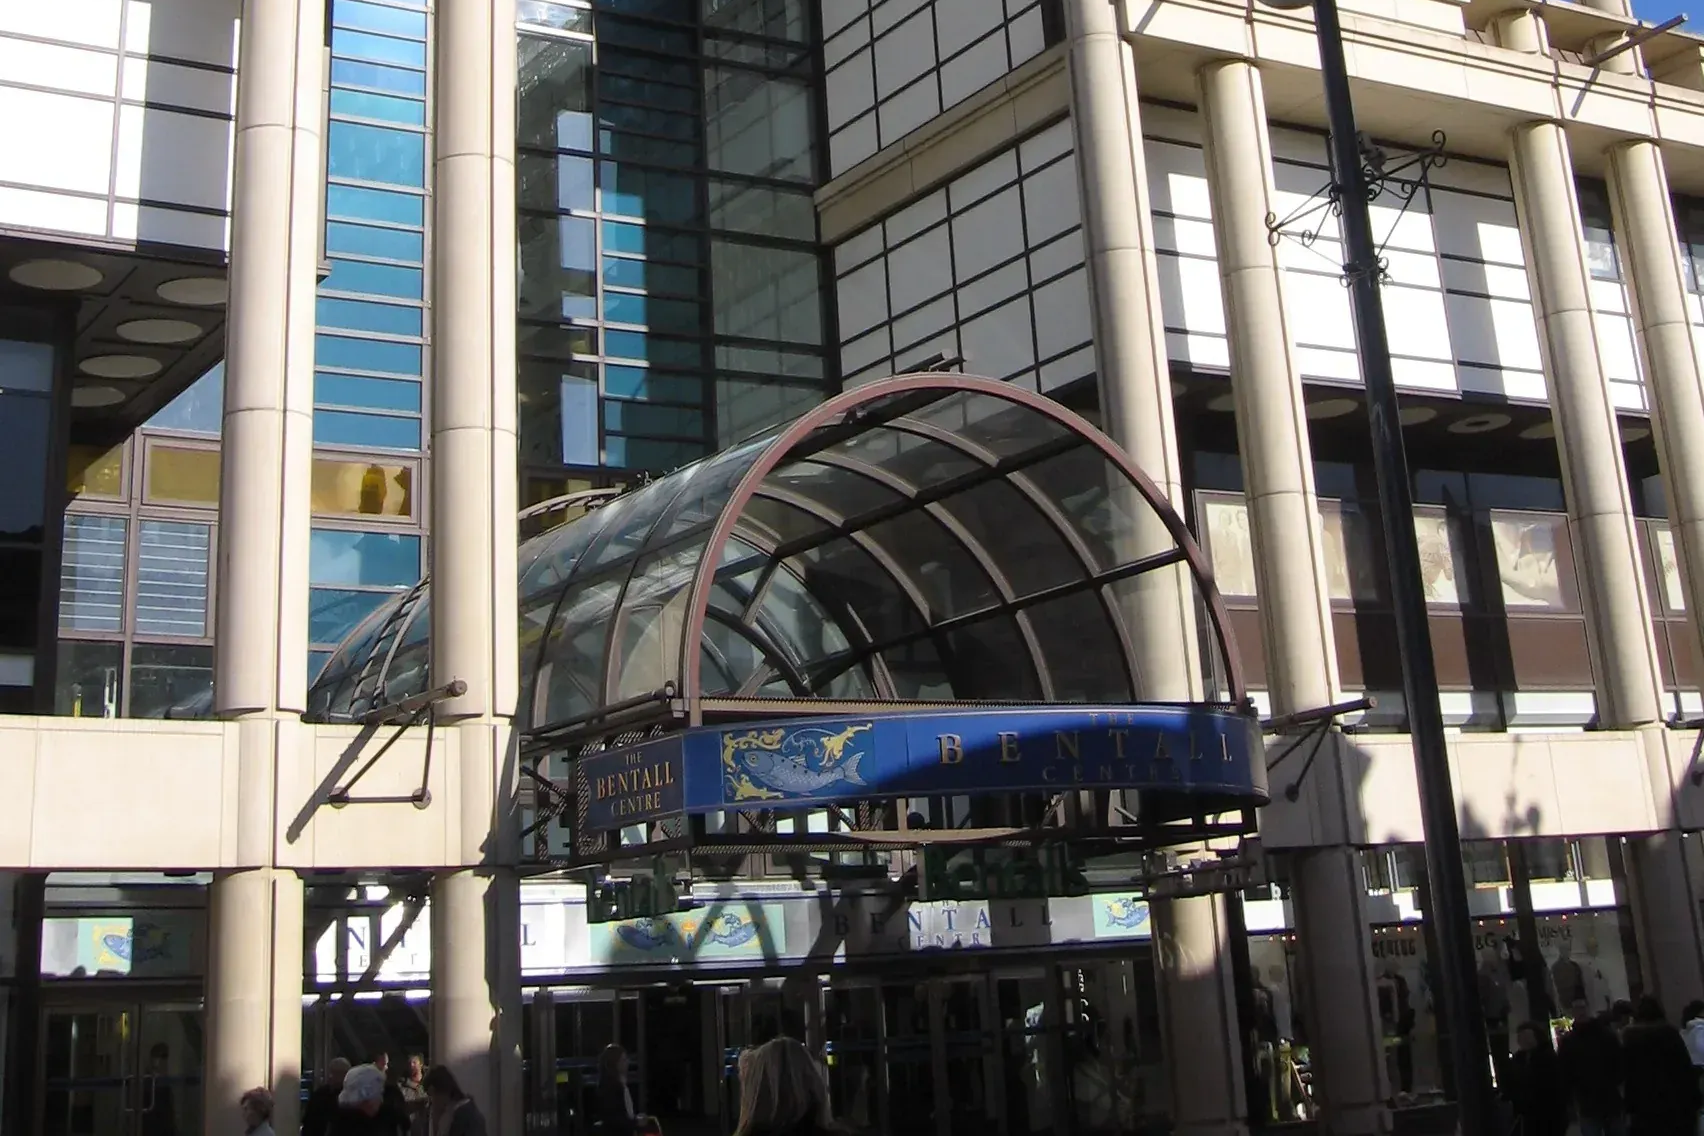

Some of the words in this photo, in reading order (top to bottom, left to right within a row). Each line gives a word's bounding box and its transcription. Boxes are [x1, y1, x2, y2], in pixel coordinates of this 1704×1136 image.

[625, 751, 642, 765] THE
[936, 728, 1232, 765] BENTALL
[596, 761, 674, 800] BENTALL
[611, 791, 661, 817] CENTRE
[833, 905, 1052, 936] BENTALL
